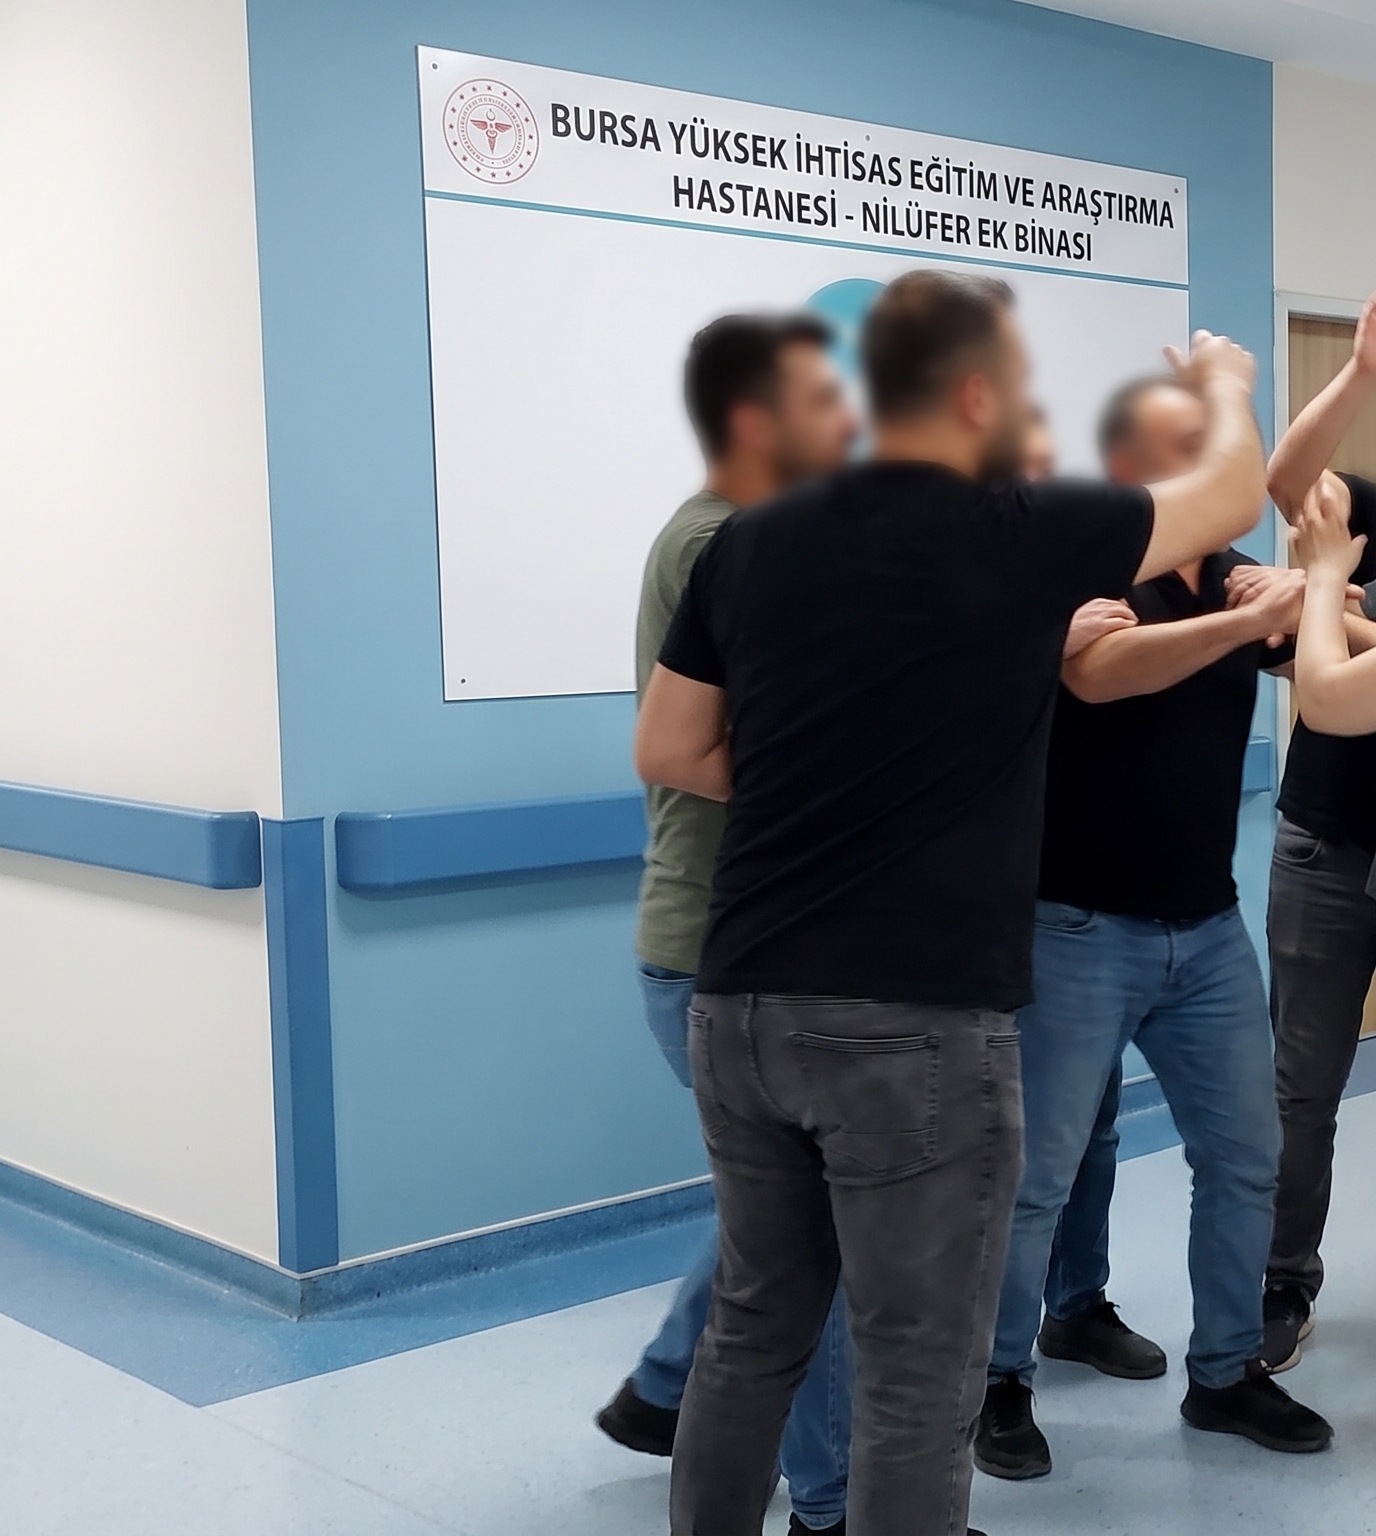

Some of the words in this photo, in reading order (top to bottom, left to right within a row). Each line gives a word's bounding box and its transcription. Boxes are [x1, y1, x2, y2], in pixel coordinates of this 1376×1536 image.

[551, 103, 662, 152] BURSA
[667, 116, 788, 171] YÜKSEK
[795, 132, 902, 187] İHTİSAS
[910, 155, 998, 202] EĞİTİM
[1003, 174, 1035, 208] VE
[1041, 181, 1174, 229] ARAŞTIRMA
[673, 175, 837, 228] HASTANESİ
[862, 196, 971, 246] NİLÜFER
[978, 217, 1009, 250] EK
[1015, 218, 1092, 262] BİNASI
